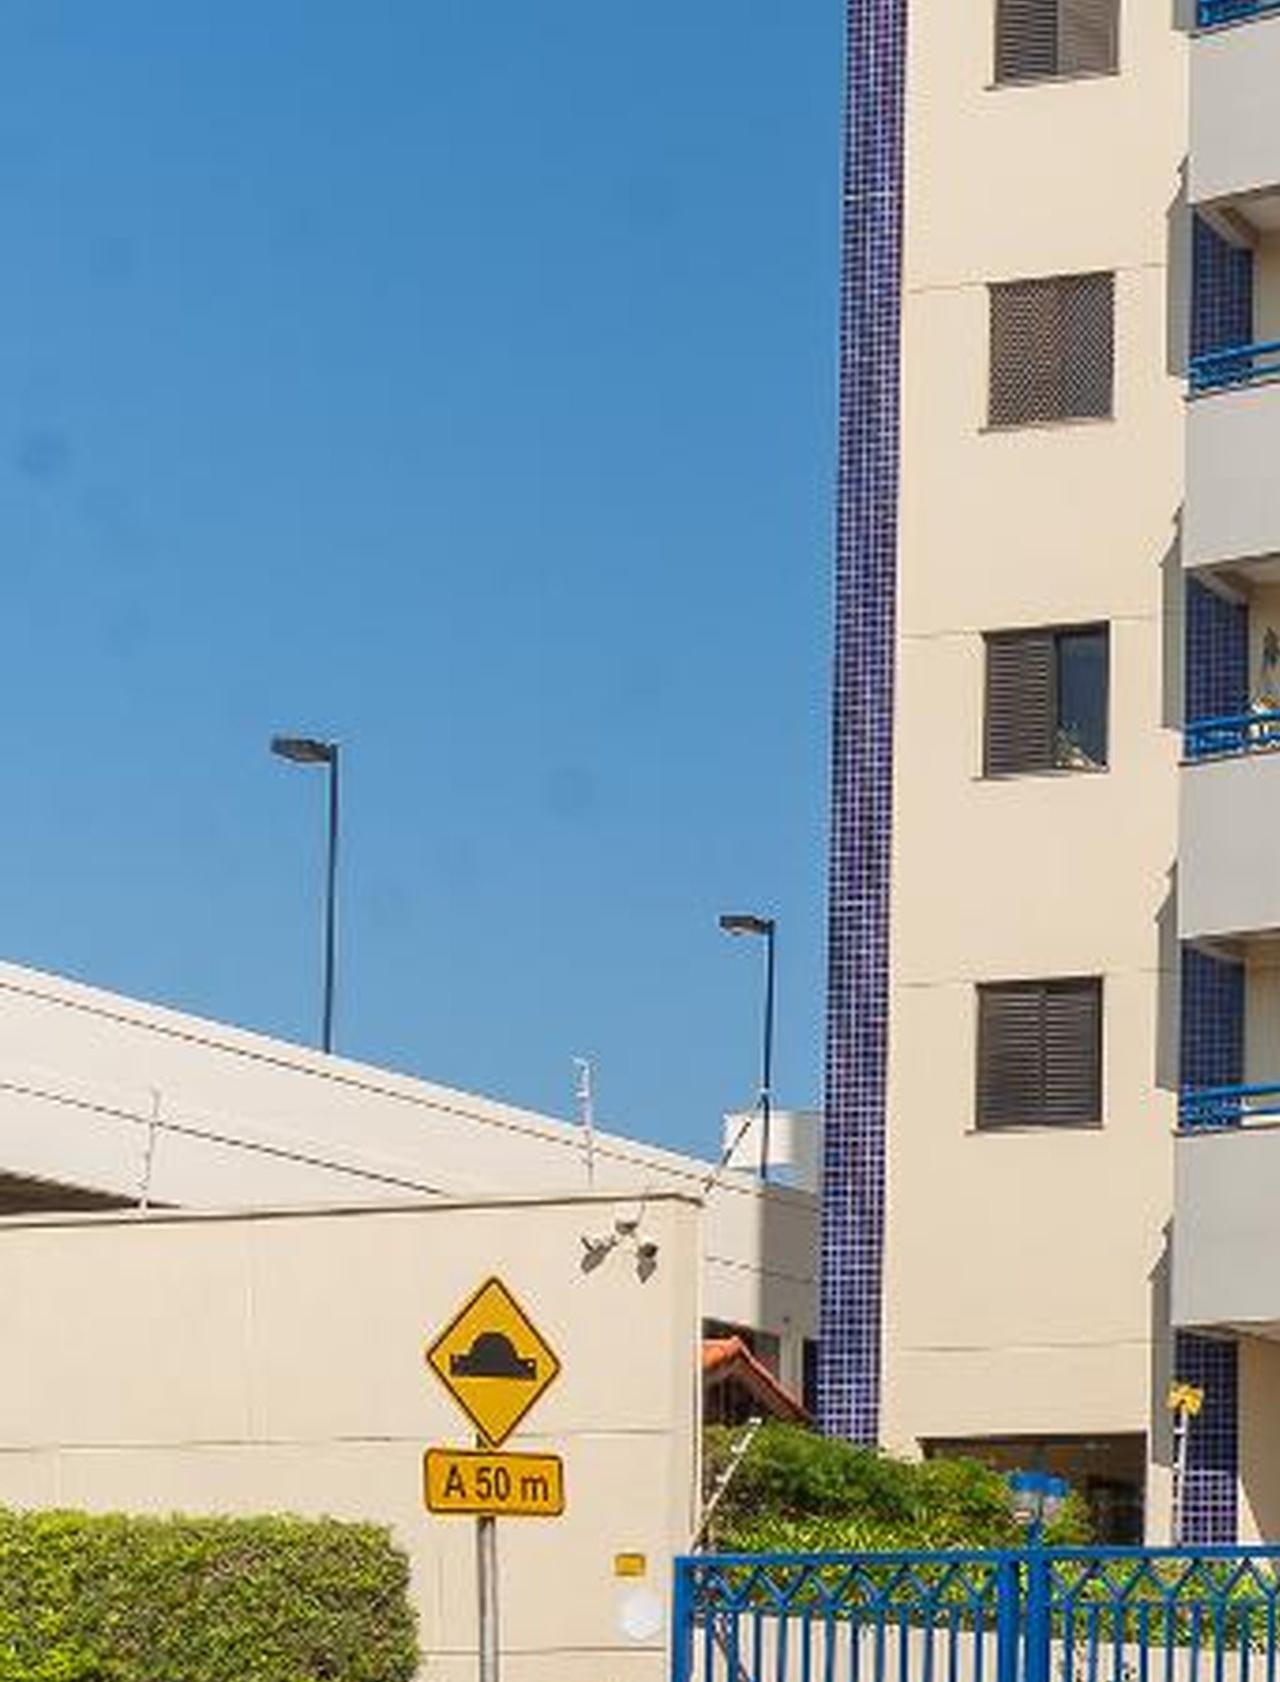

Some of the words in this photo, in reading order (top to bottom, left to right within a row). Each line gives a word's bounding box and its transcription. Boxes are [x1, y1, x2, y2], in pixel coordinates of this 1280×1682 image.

[443, 1464, 467, 1499] A
[474, 1465, 511, 1501] 50
[520, 1474, 550, 1502] m
